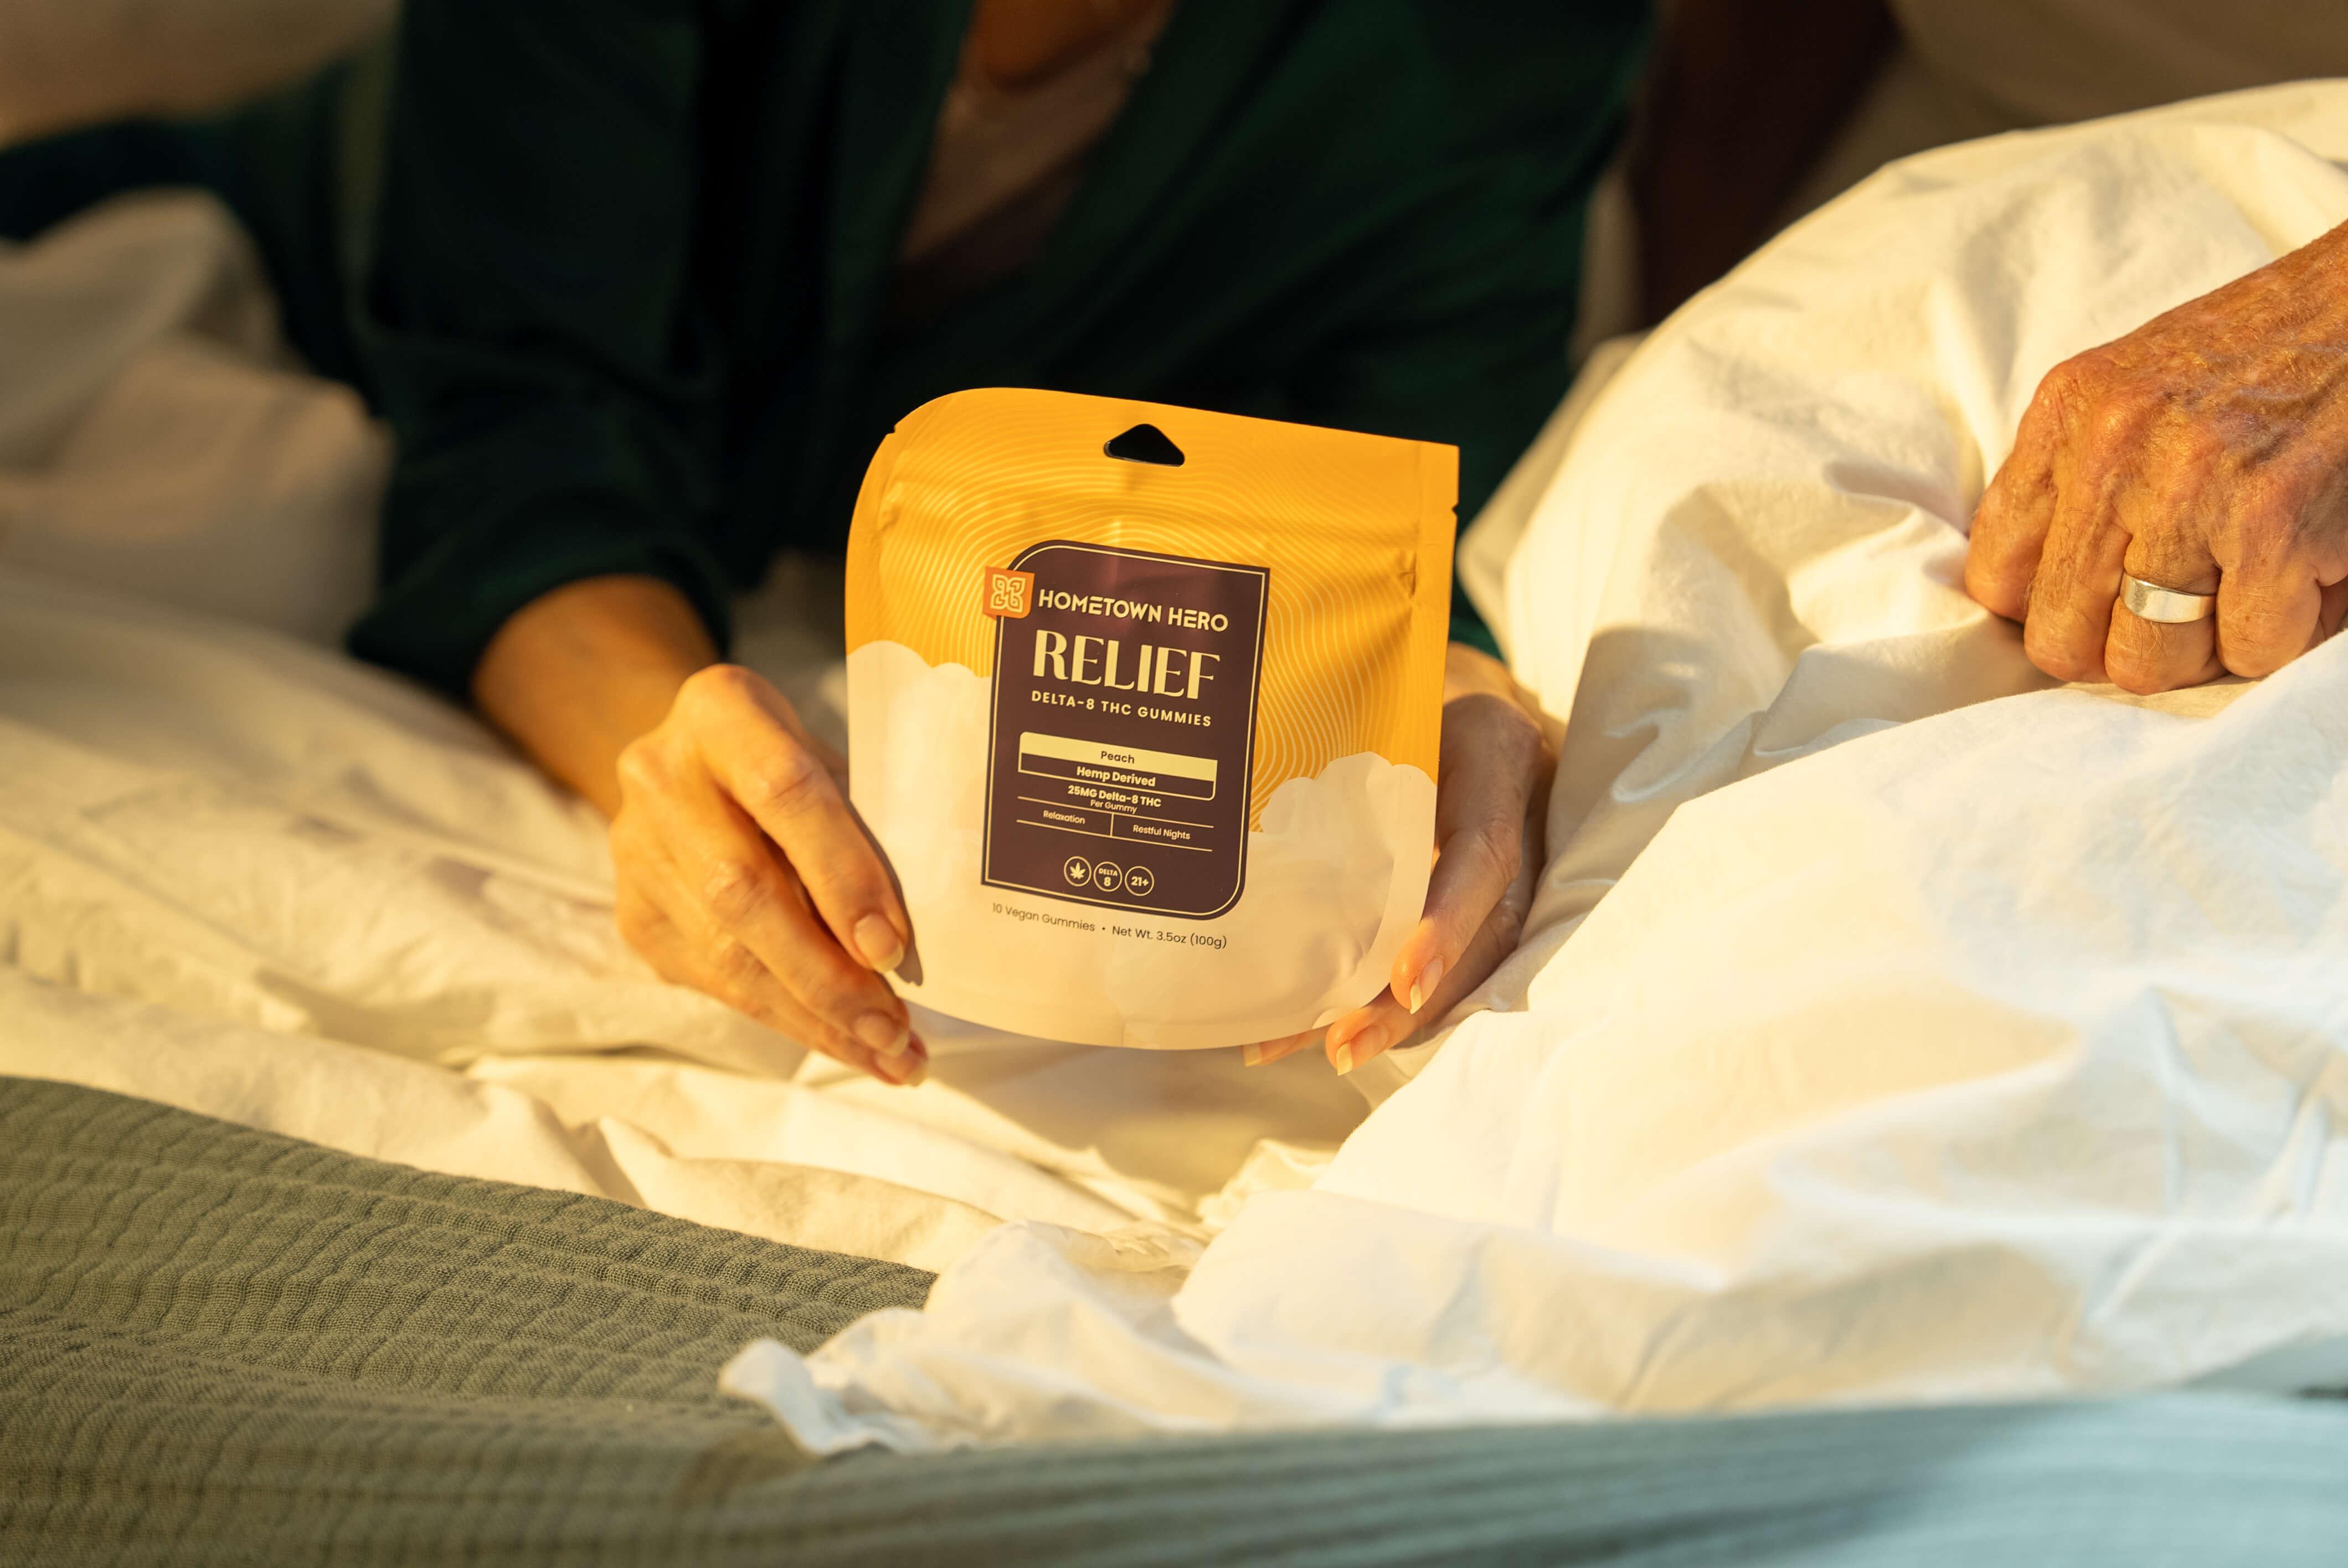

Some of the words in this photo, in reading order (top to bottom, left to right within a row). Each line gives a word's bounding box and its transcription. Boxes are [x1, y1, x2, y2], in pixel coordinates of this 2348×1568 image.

[1038, 590, 1162, 622] HOMETOWN
[1168, 607, 1228, 631] HERO
[1033, 630, 1220, 699] RELIEF
[1032, 690, 1094, 710] DELTA-8
[1101, 702, 1131, 715] THC
[1138, 706, 1211, 727] GUMMIES
[1101, 751, 1135, 764] Peach
[1077, 766, 1110, 782] Hemp
[1112, 772, 1155, 786] Derived
[1068, 785, 1097, 798] 25MG
[1099, 791, 1138, 804] Delta-8
[1140, 796, 1161, 807] THC
[1105, 801, 1137, 814] Gummy
[1043, 810, 1085, 824] Relaxation
[1133, 824, 1161, 836] Restful
[1163, 828, 1190, 840] Nights
[1099, 867, 1118, 876] DELTA
[1104, 877, 1110, 886] 8
[1131, 876, 1149, 886] 21+
[992, 903, 1002, 913] 10
[1005, 906, 1038, 922] Vegan
[1042, 914, 1095, 931] Gummies
[1113, 926, 1132, 937] Net
[1135, 928, 1153, 940] Wt.
[1156, 932, 1186, 943] 3.5oz
[1190, 934, 1227, 949] (100g)
